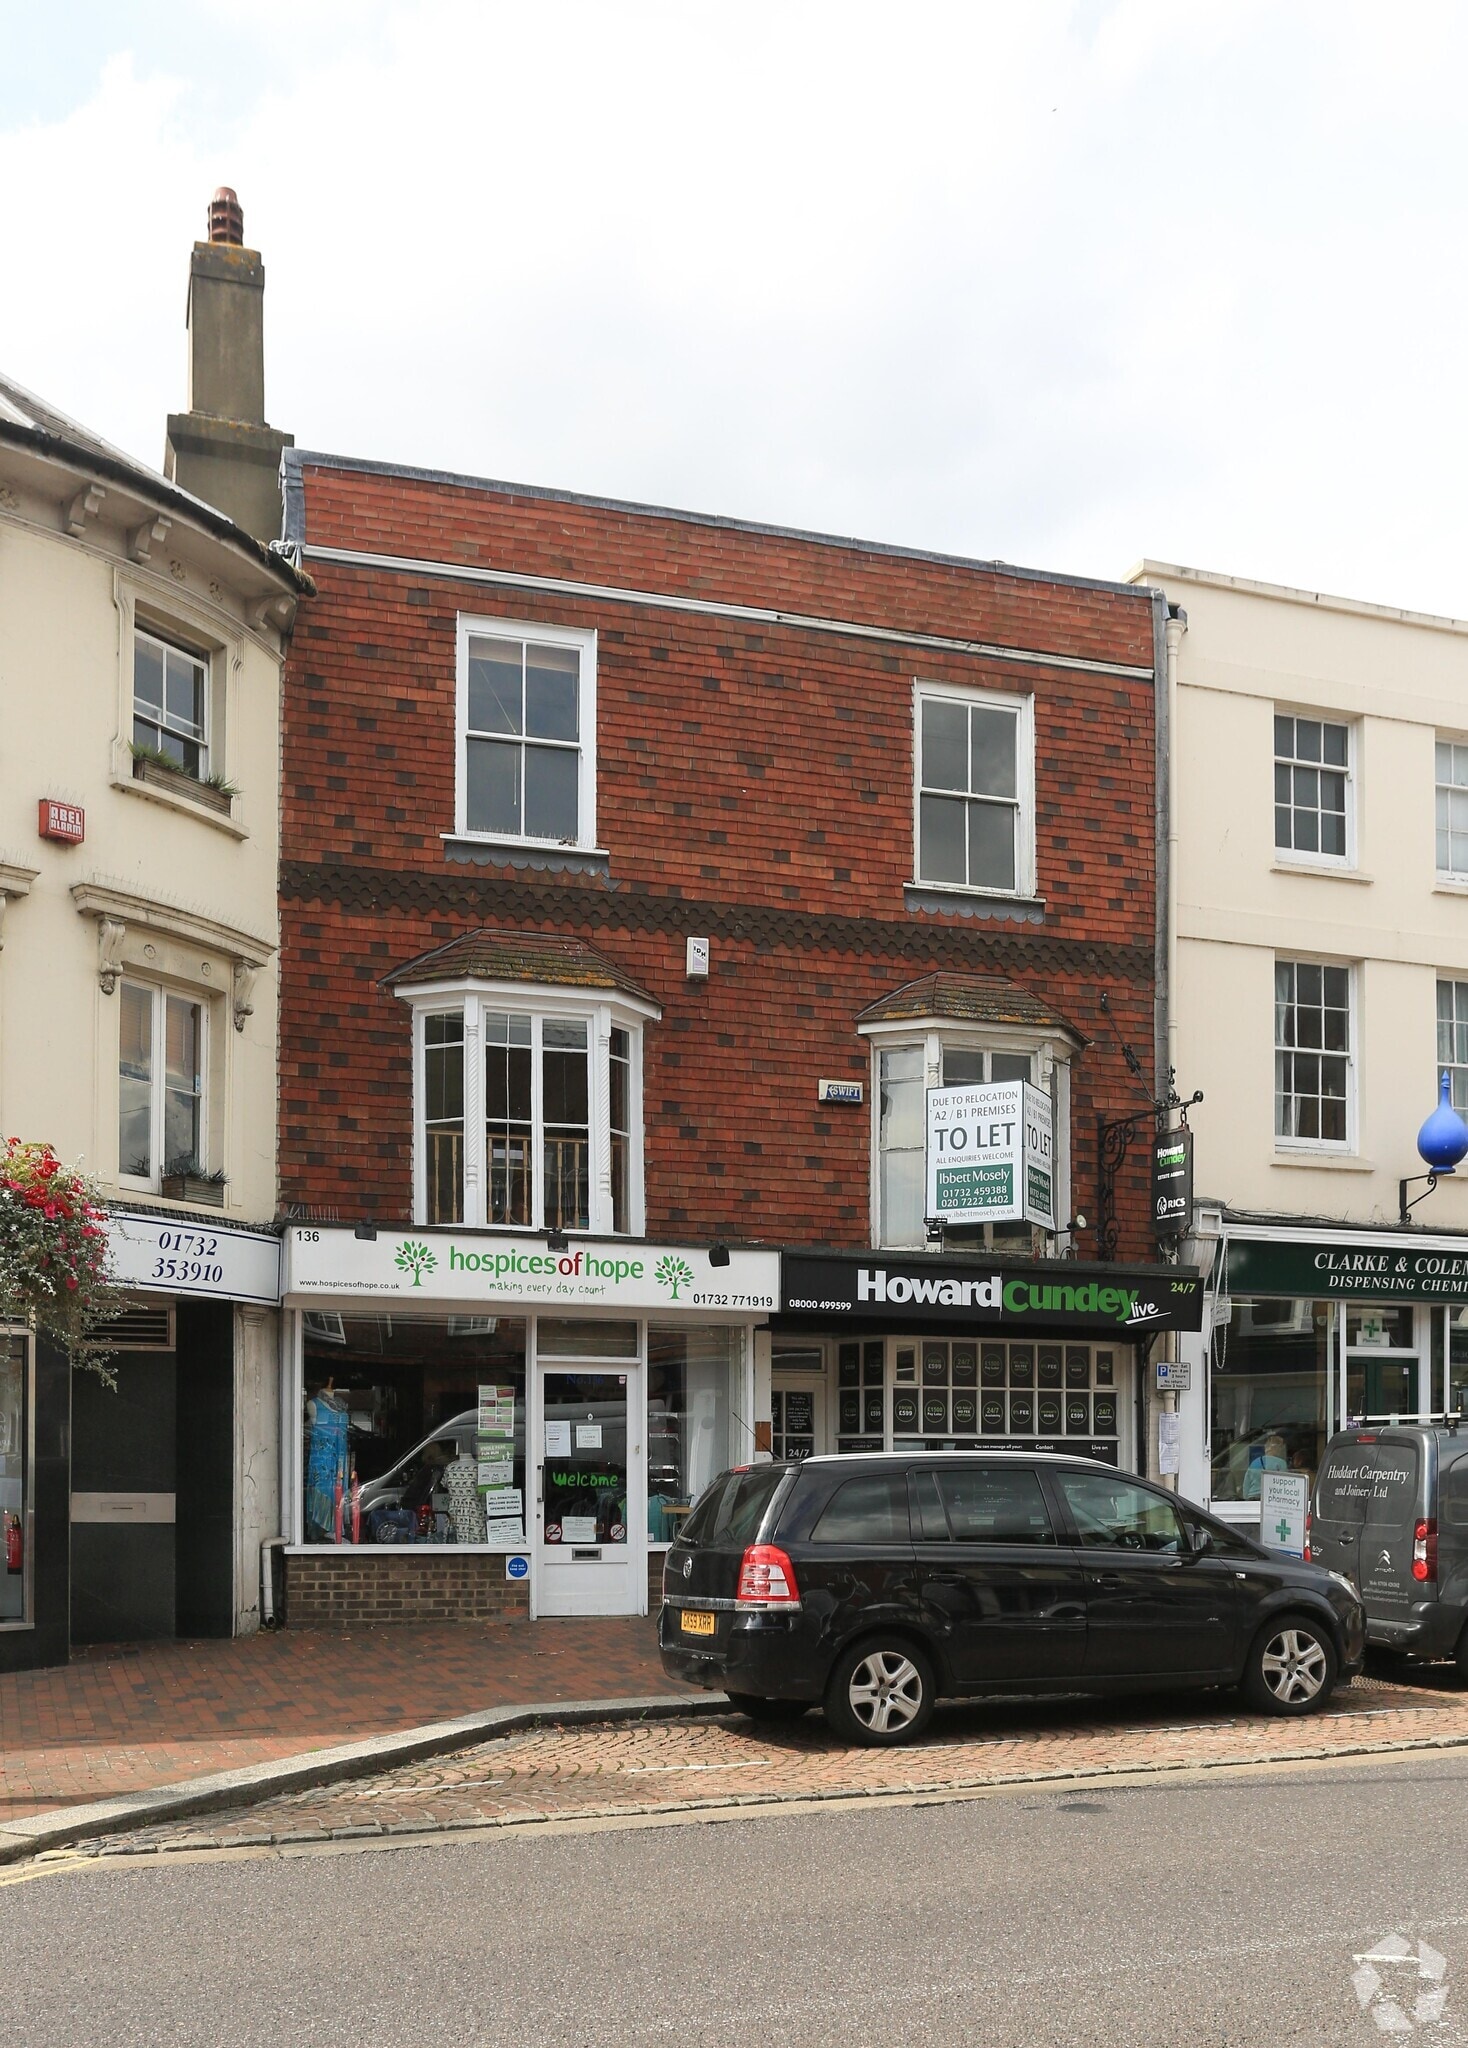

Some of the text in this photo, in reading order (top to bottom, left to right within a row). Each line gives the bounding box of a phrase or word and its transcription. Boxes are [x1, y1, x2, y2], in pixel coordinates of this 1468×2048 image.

[51, 806, 80, 825] ABEL
[51, 819, 80, 835] ALARM
[833, 1086, 858, 1096] SWIFT
[932, 1091, 1018, 1107] DUE TO RELOCATION
[934, 1111, 946, 1120] A2
[956, 1108, 968, 1119] B1
[971, 1104, 1016, 1117] PREMISES
[934, 1122, 1016, 1152] TO LET
[1027, 1124, 1051, 1158] TO LET
[948, 1154, 981, 1163] ENQUIRIES
[982, 1152, 1014, 1160] WELCOME
[1158, 1143, 1184, 1158] Howard
[1160, 1154, 1186, 1166] Cundey
[939, 1168, 1010, 1184] Ibbett Mosely
[943, 1186, 1007, 1198] 01732 459388
[941, 1195, 1009, 1208] 020 7222 4402
[1168, 1198, 1186, 1208] RICS
[934, 1208, 1016, 1219] www.ibbettmosely.co.uk
[296, 1230, 320, 1242] 136
[158, 1232, 218, 1256] 01732
[1314, 1252, 1390, 1272] CLARKE
[1394, 1256, 1408, 1272] &
[152, 1258, 222, 1282] 353910
[299, 1279, 400, 1290] www.hospicesofhope.co.uk
[489, 1282, 606, 1296] making every day count
[1170, 1282, 1196, 1294] 24/7
[1328, 1275, 1416, 1290] DISPENSING
[693, 1293, 773, 1308] 01732 771919
[789, 1299, 852, 1310] 08000 499599
[1131, 1301, 1160, 1318] live
[788, 1449, 809, 1457] 24/7
[1328, 1465, 1410, 1484] Huddart Carpentry
[1272, 1477, 1296, 1487] support
[1284, 1488, 1300, 1496] local
[1334, 1484, 1388, 1498] and Joinery Ltd
[1268, 1495, 1300, 1507] pharmacy
